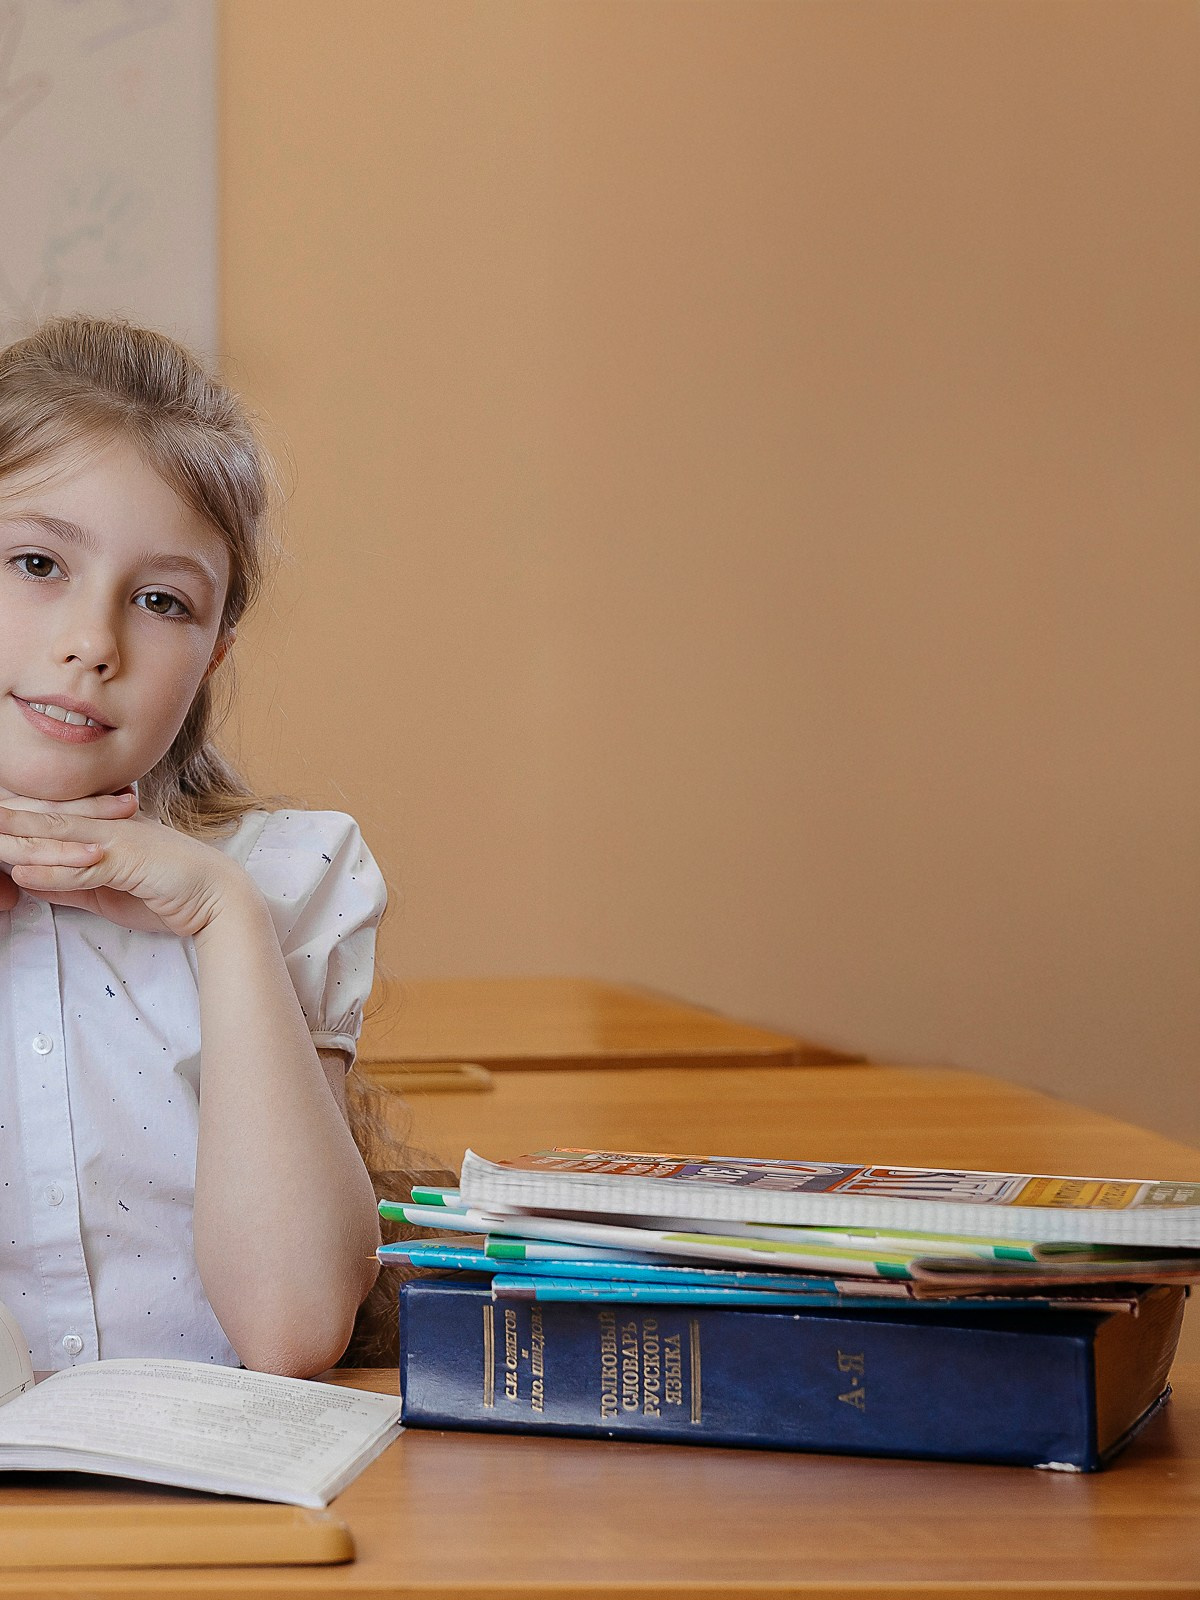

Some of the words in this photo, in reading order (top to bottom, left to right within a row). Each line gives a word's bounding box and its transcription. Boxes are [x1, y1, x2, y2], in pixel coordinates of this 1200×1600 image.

[505, 1309, 517, 1369] ОЖЕГОВ
[598, 1312, 618, 1420] ТОЛКОВЫЙ
[621, 1320, 639, 1412] СЛОВАРЬ
[643, 1317, 660, 1417] РУССКОГО
[665, 1333, 682, 1405] ЯЗЫКА
